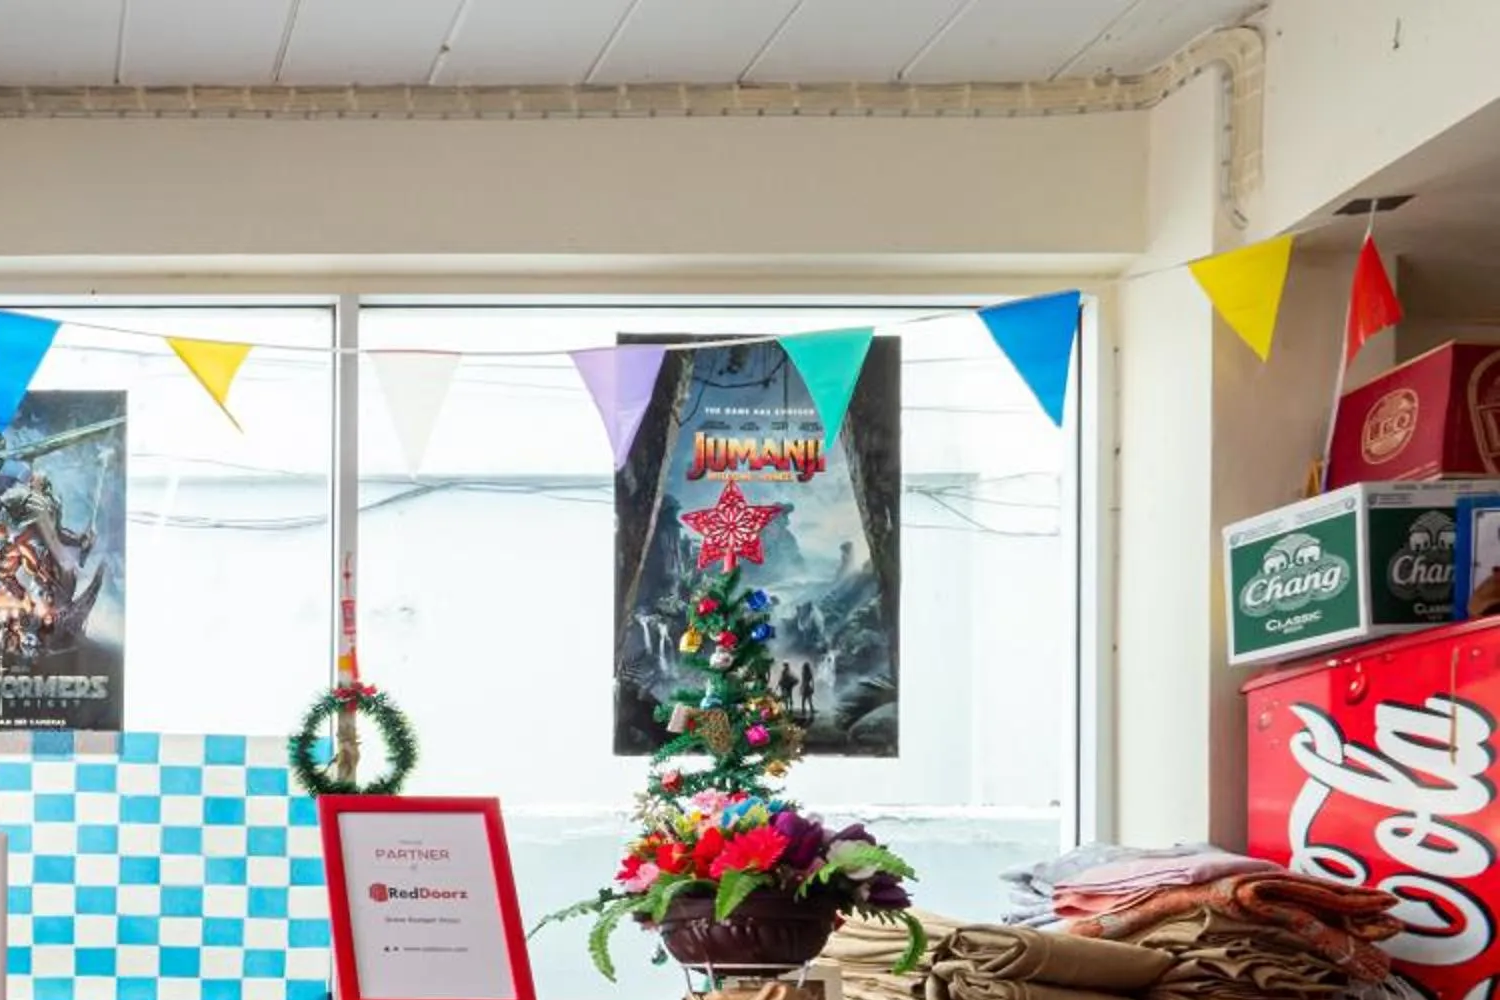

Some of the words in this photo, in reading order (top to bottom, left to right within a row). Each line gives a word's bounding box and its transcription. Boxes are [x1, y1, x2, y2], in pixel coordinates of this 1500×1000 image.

[686, 431, 827, 483] JUMANJI
[1244, 563, 1342, 609] Chang
[1392, 555, 1457, 586] Chan
[1265, 609, 1323, 632] CLASSIC
[1288, 691, 1492, 968] Cola
[374, 848, 451, 861] PARTNER
[387, 886, 469, 900] RedDoorz
